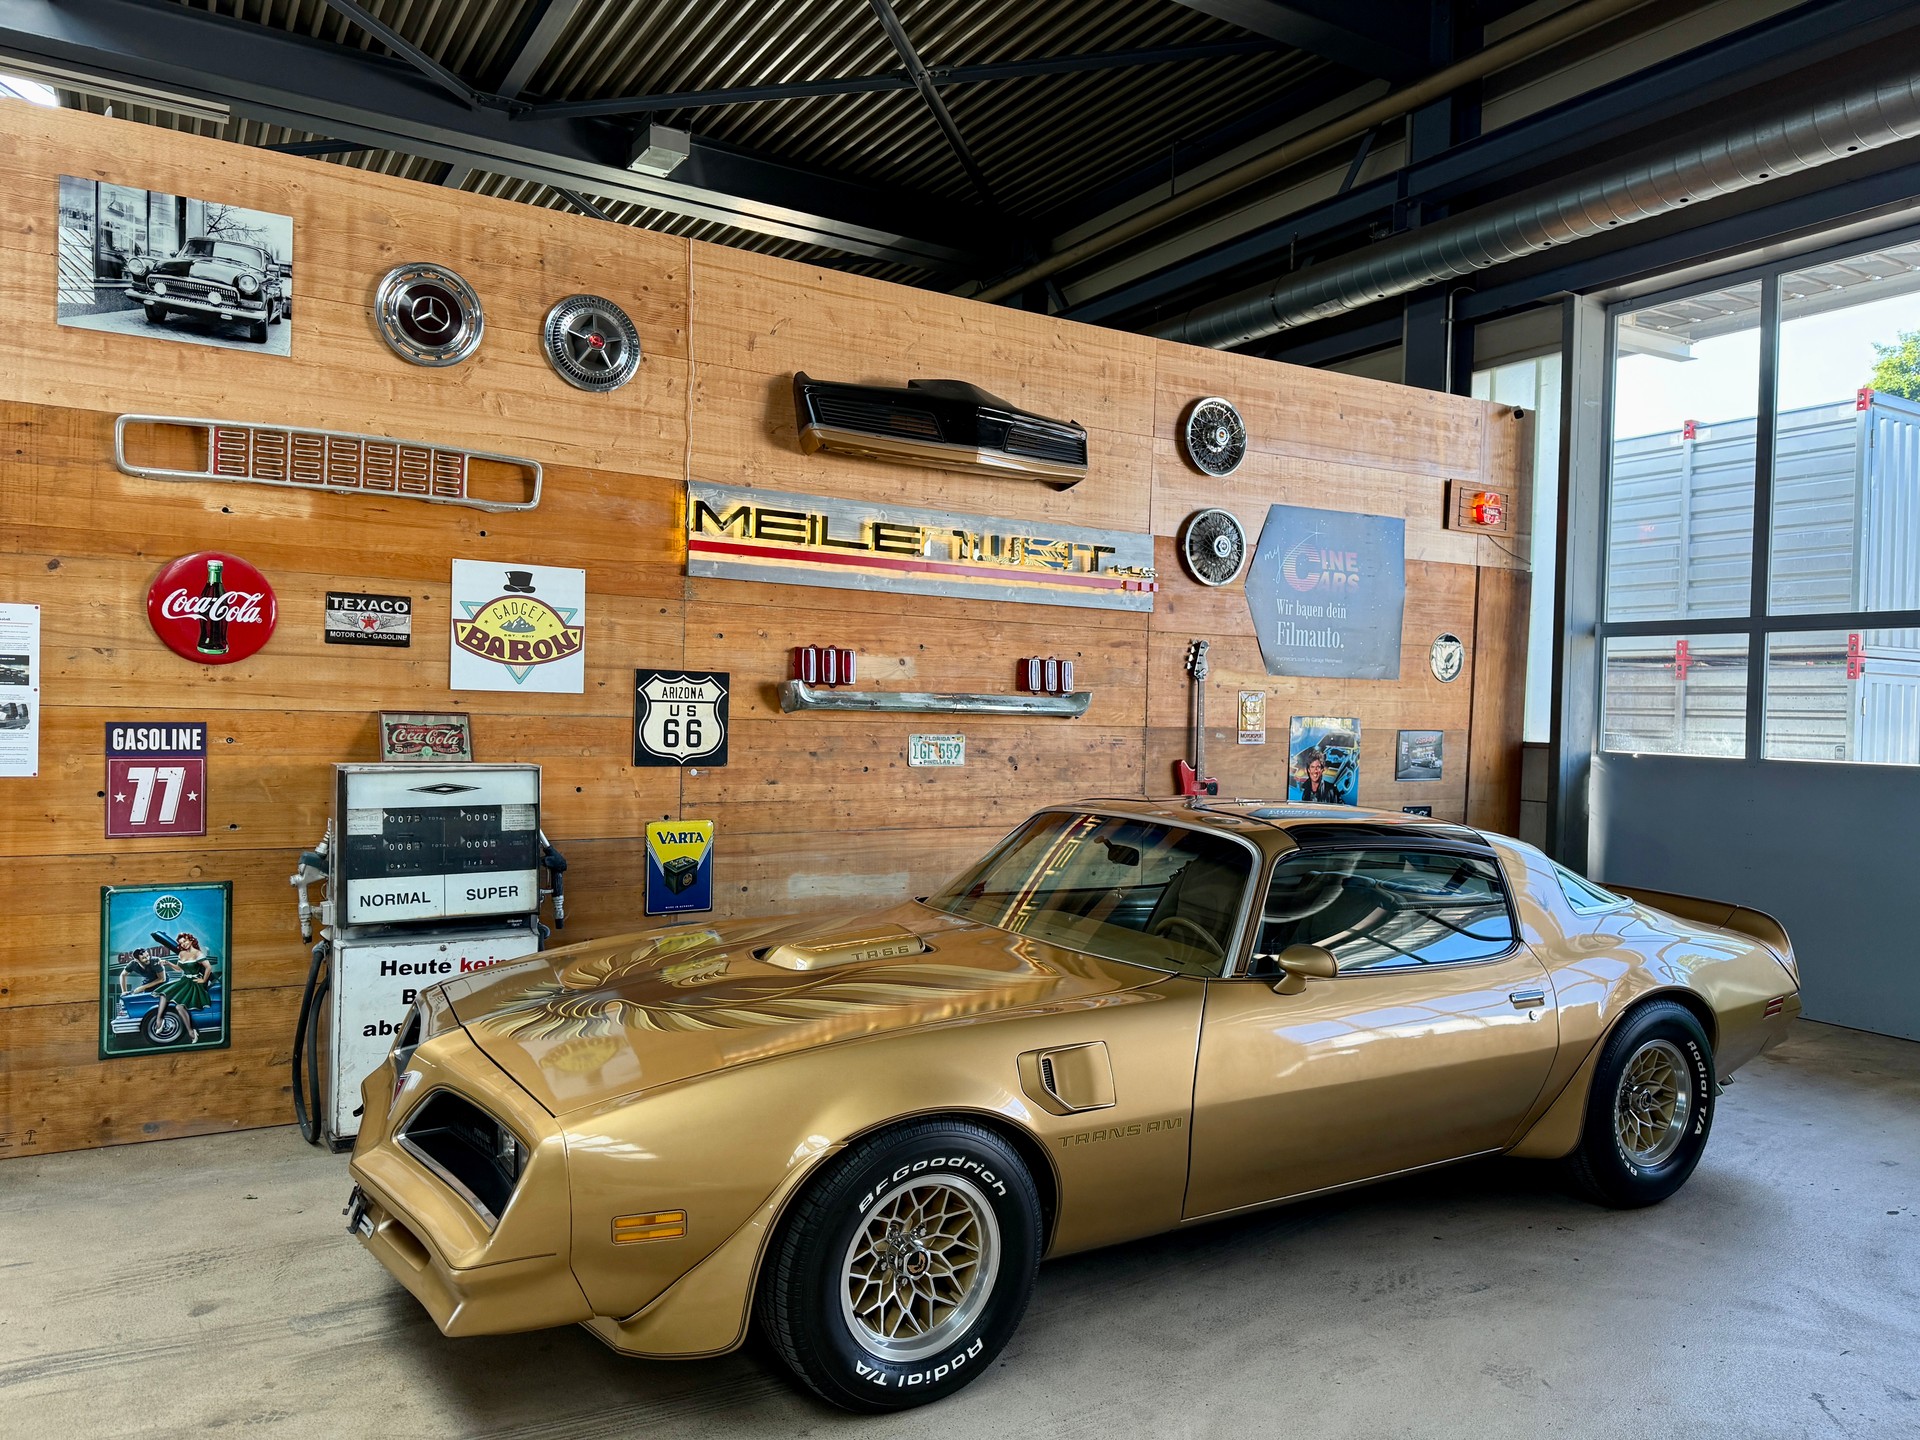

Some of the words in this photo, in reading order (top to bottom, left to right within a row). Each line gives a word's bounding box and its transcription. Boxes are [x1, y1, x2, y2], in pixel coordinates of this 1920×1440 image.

[161, 588, 265, 623] Coca-Cola
[330, 596, 409, 613] TEXACO
[492, 601, 547, 622] GADGET
[1276, 598, 1294, 616] Wir
[1296, 600, 1323, 618] bauen
[1326, 602, 1347, 619] dein
[372, 633, 408, 641] GASOLINE
[461, 625, 578, 661] BARON
[1276, 621, 1345, 649] Filmauto.
[661, 686, 704, 699] ARIZONA
[112, 727, 202, 751] GASOLINE
[391, 728, 461, 745] Coca-Cola
[663, 718, 702, 748] 66
[127, 767, 187, 825] 77
[657, 831, 705, 845] VARTA
[359, 890, 431, 908] NORMAL
[466, 885, 519, 901] SUPER
[380, 958, 452, 977] Heute
[1686, 1040, 1709, 1099] Radial
[1058, 1124, 1142, 1149] TRANS
[1146, 1117, 1184, 1134] AM
[1694, 1105, 1708, 1135] T/A
[855, 1359, 888, 1387] T/A
[897, 1337, 984, 1388] Radial
